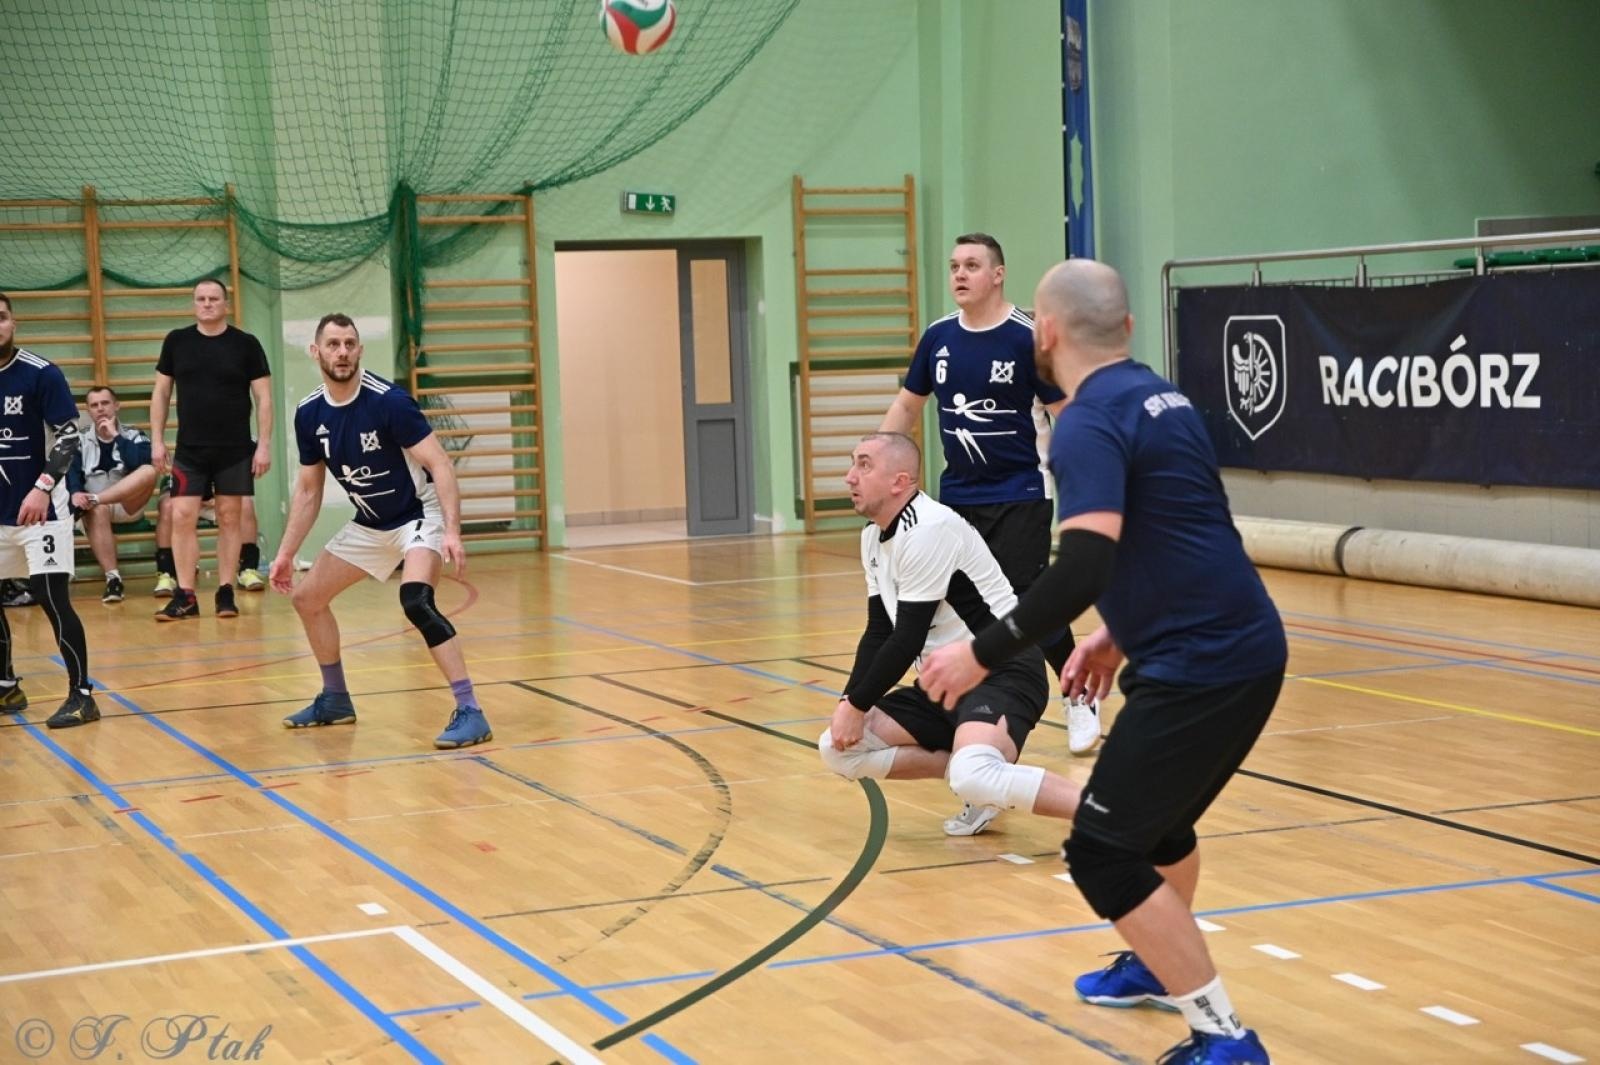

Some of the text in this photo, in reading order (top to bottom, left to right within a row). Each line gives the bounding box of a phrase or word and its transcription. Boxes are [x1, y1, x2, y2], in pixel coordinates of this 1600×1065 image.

[935, 359, 948, 384] 6
[1318, 334, 1541, 409] RACIBÓRZ
[42, 534, 56, 554] 3
